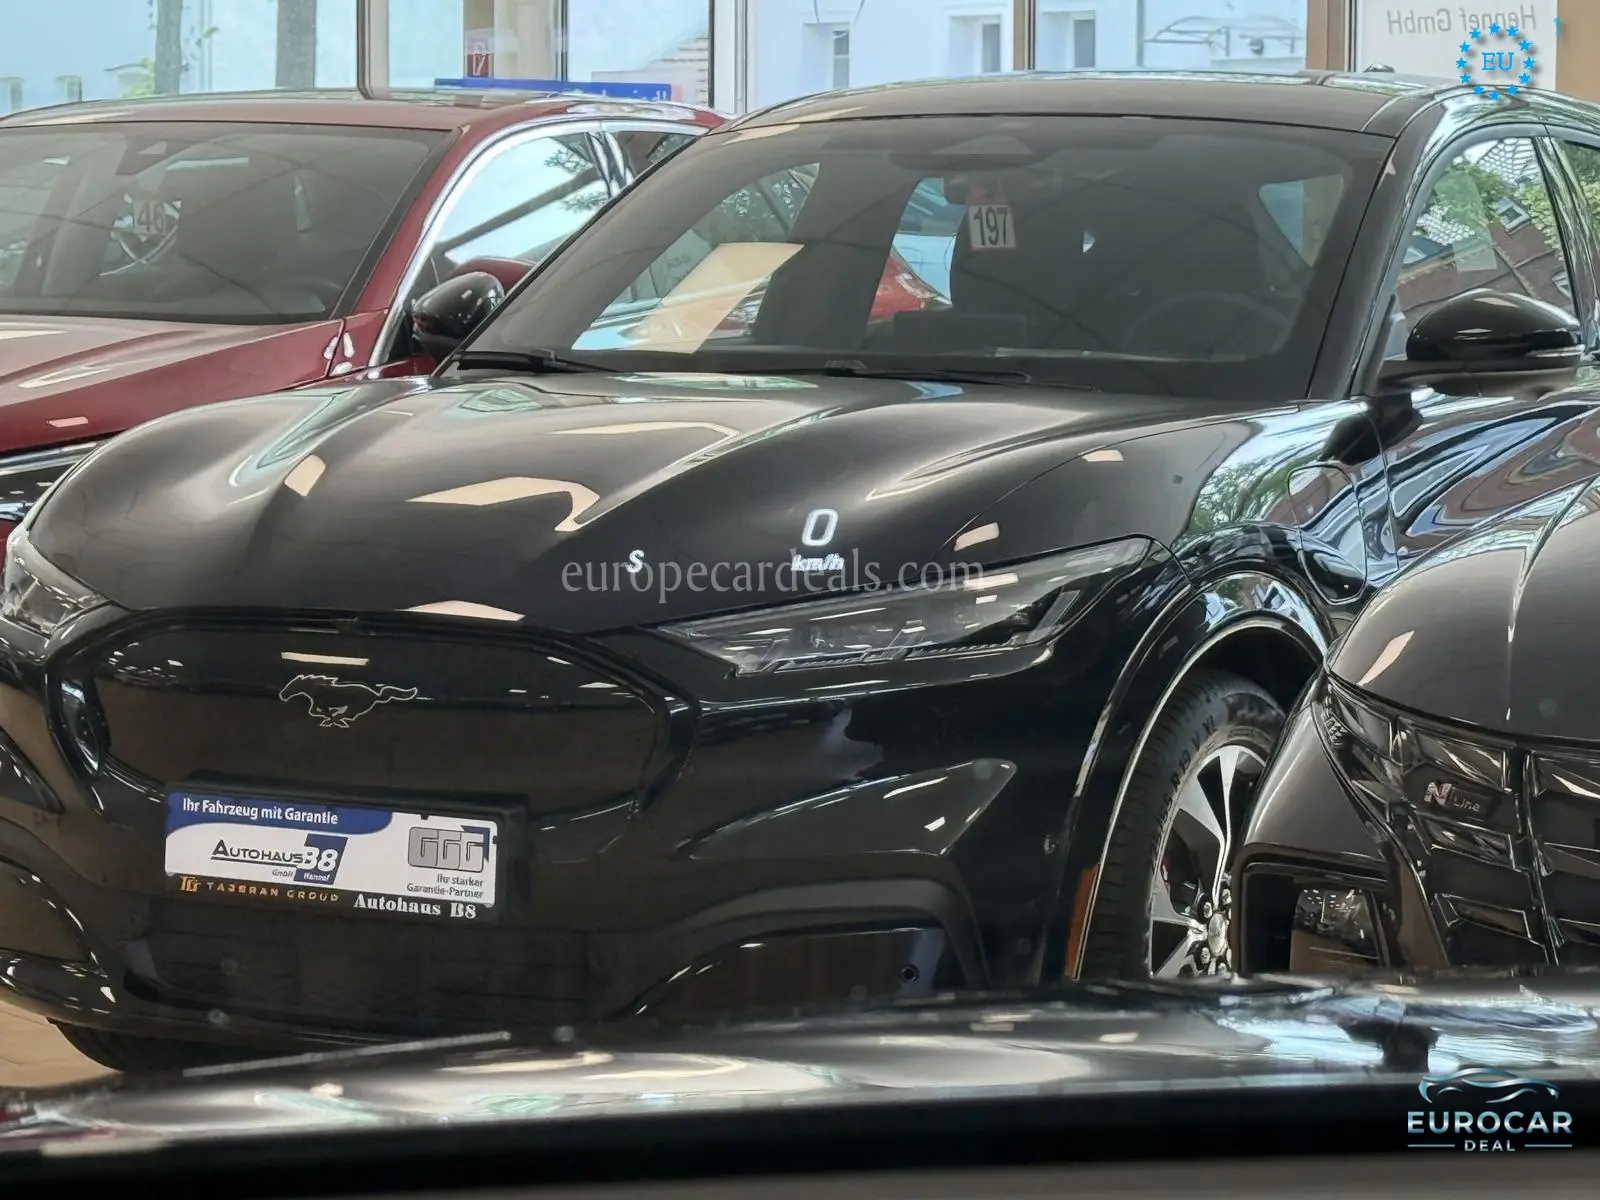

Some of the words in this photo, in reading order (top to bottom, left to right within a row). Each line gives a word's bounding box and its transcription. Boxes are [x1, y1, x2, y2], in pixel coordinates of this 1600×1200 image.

[974, 206, 1008, 246] 197
[801, 508, 839, 547] 0
[791, 553, 845, 572] km/h
[1424, 782, 1453, 806] N
[183, 797, 201, 812] Ihr
[202, 800, 259, 820] Fahrzeug
[261, 806, 283, 820] mit
[284, 808, 339, 825] Garantie
[287, 889, 340, 903] GROUP
[354, 893, 442, 916] Autohaus
